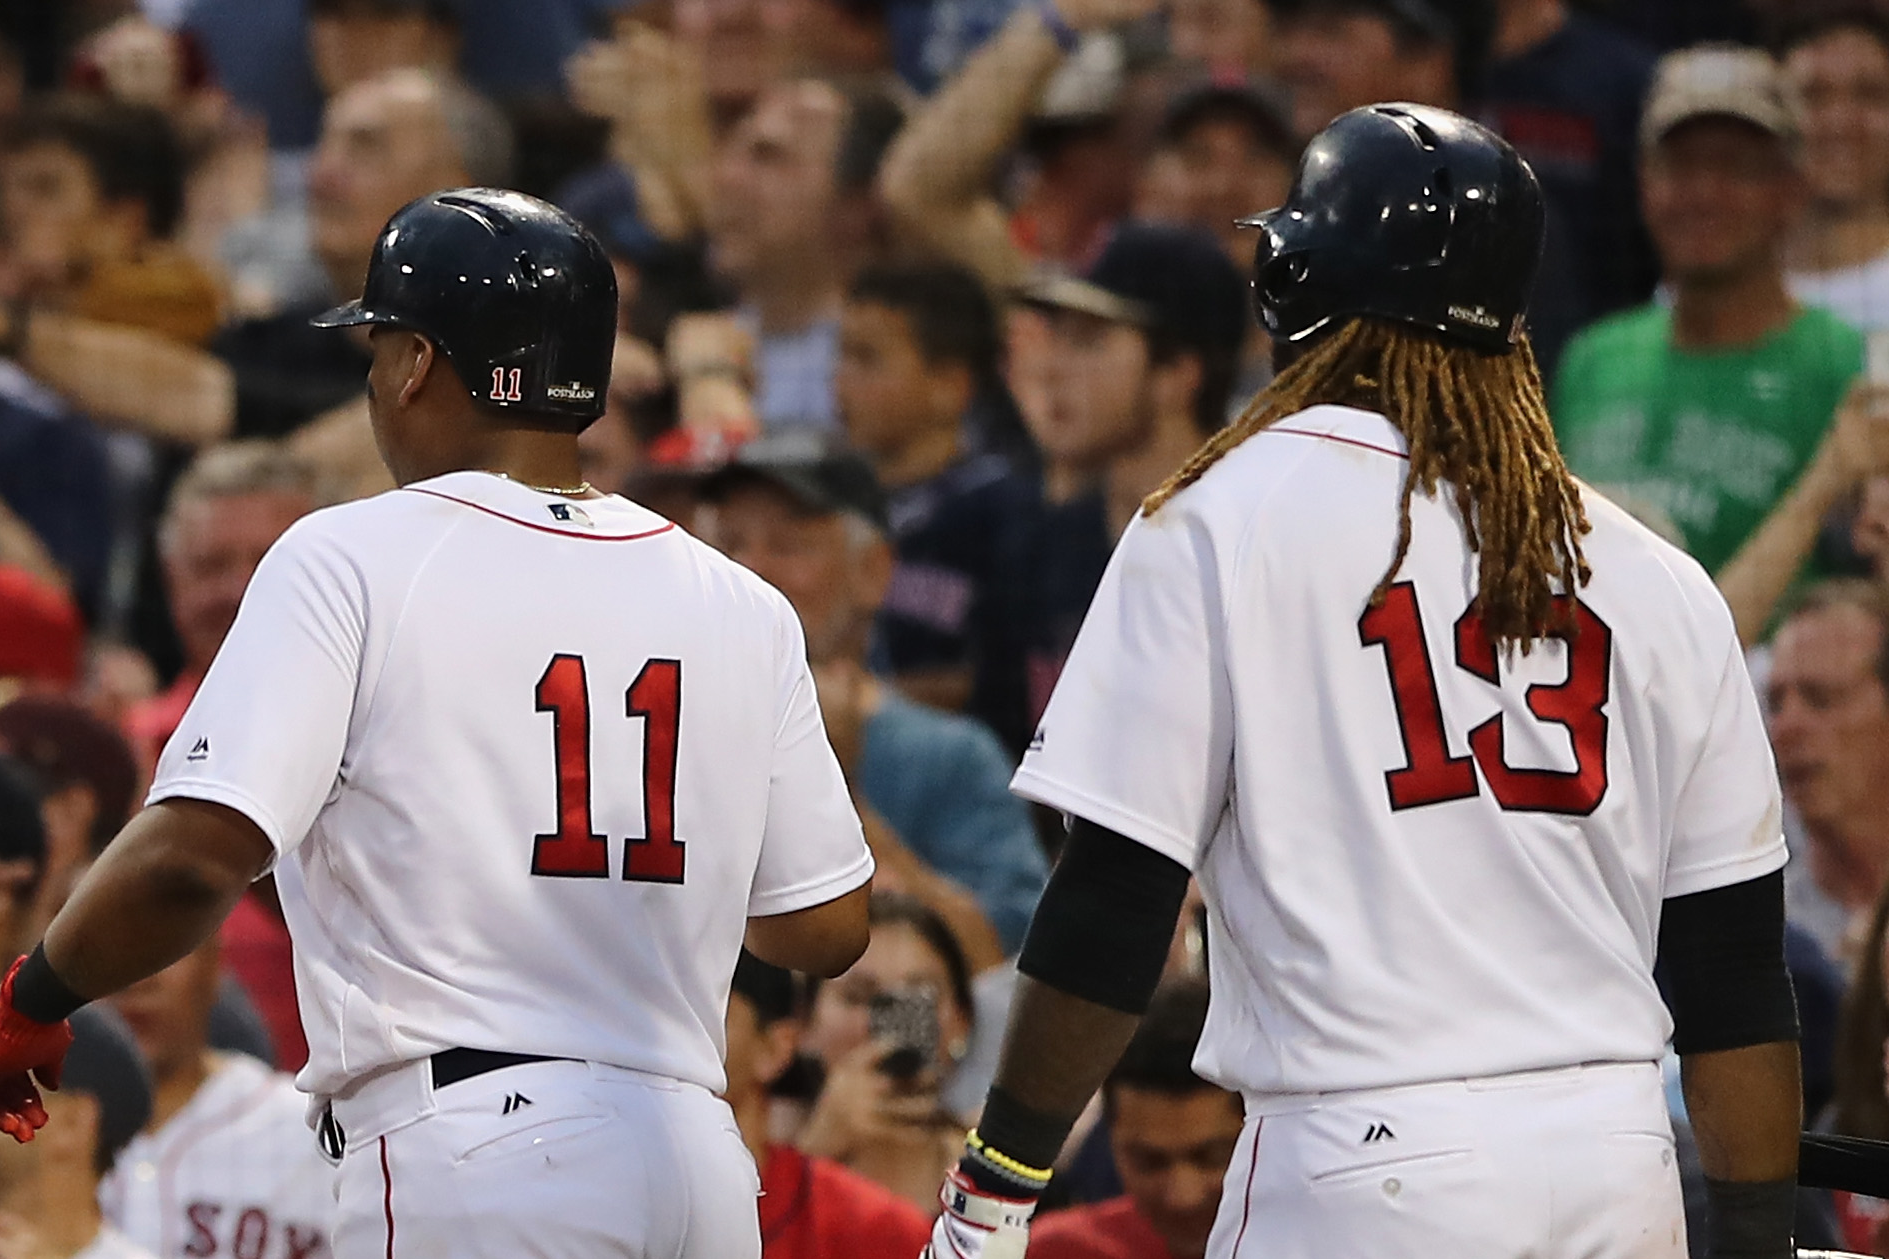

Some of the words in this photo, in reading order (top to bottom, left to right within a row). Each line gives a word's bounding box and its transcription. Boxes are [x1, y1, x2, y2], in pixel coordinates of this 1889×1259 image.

[490, 366, 522, 402] 11
[547, 387, 595, 399] POSTSEASON
[1357, 580, 1612, 817] 13
[531, 653, 686, 886] 11
